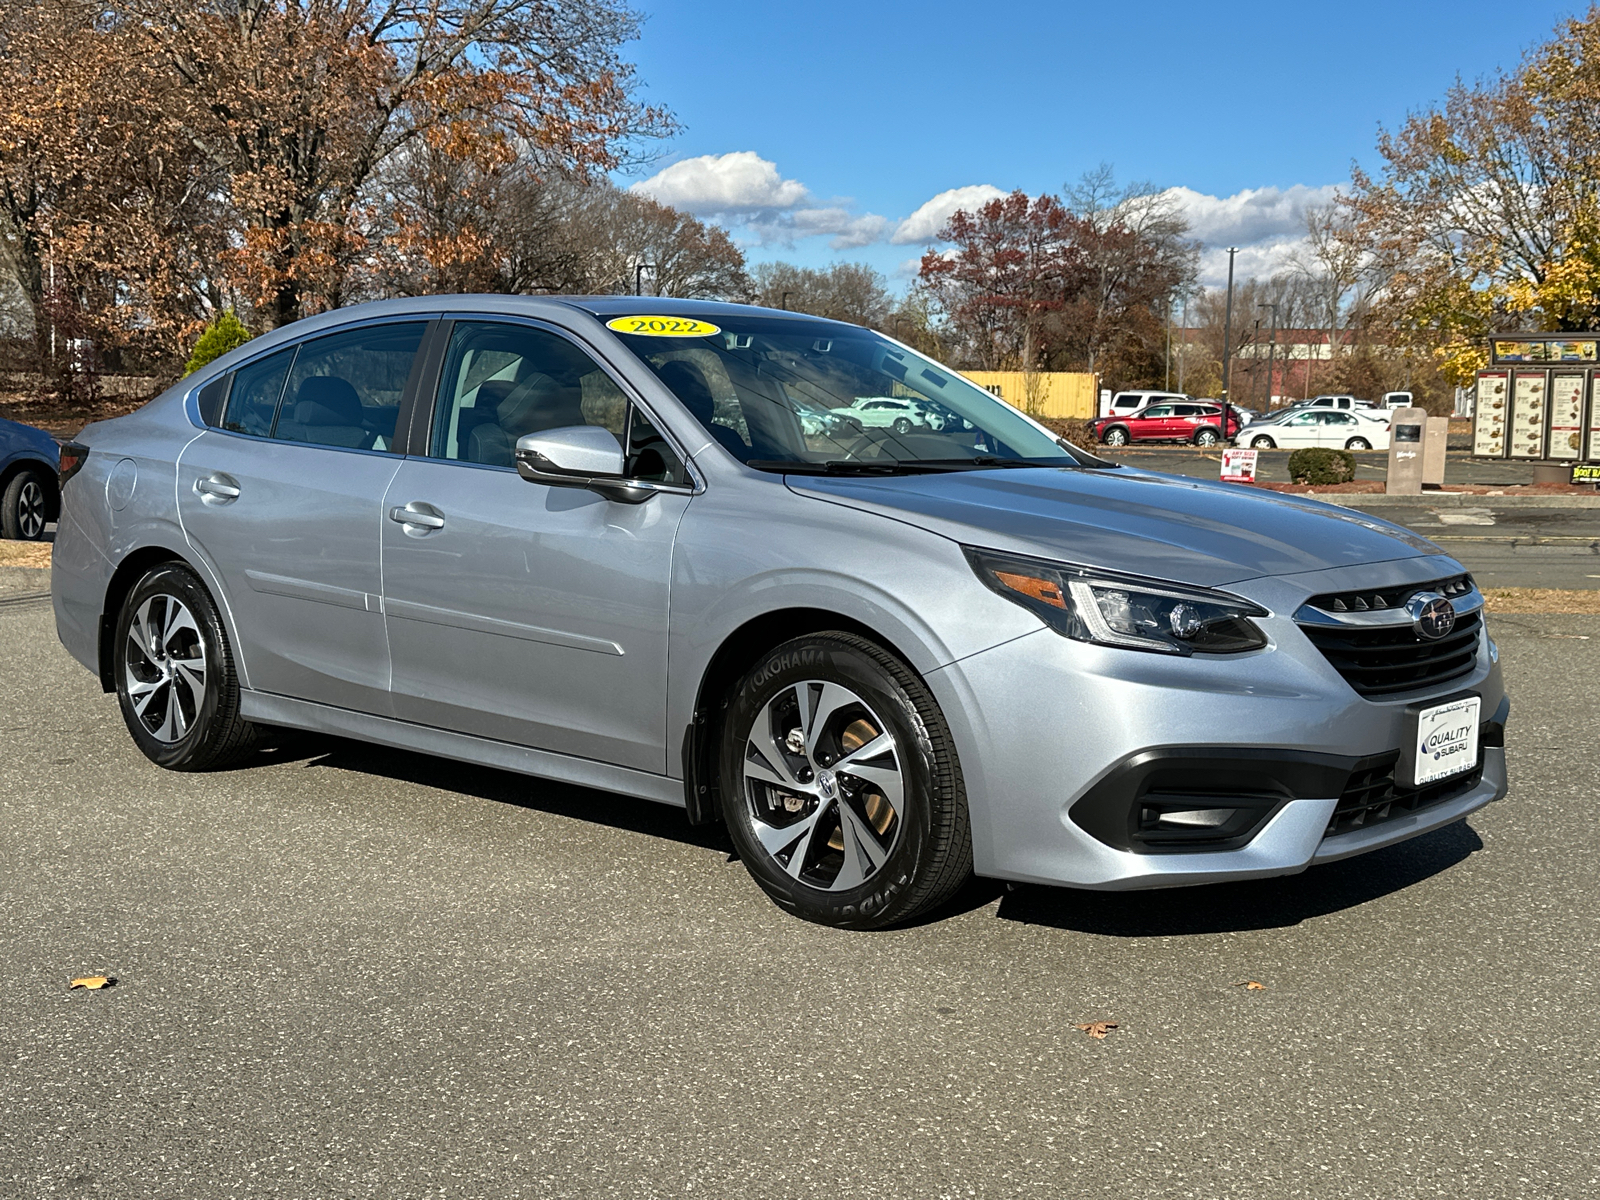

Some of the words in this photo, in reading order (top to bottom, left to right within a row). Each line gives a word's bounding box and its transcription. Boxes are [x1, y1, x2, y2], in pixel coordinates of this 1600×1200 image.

[630, 320, 702, 333] 2022
[750, 650, 825, 693] YOKOHAMA
[1430, 724, 1472, 747] QUALITY
[1441, 741, 1468, 757] SUBARU
